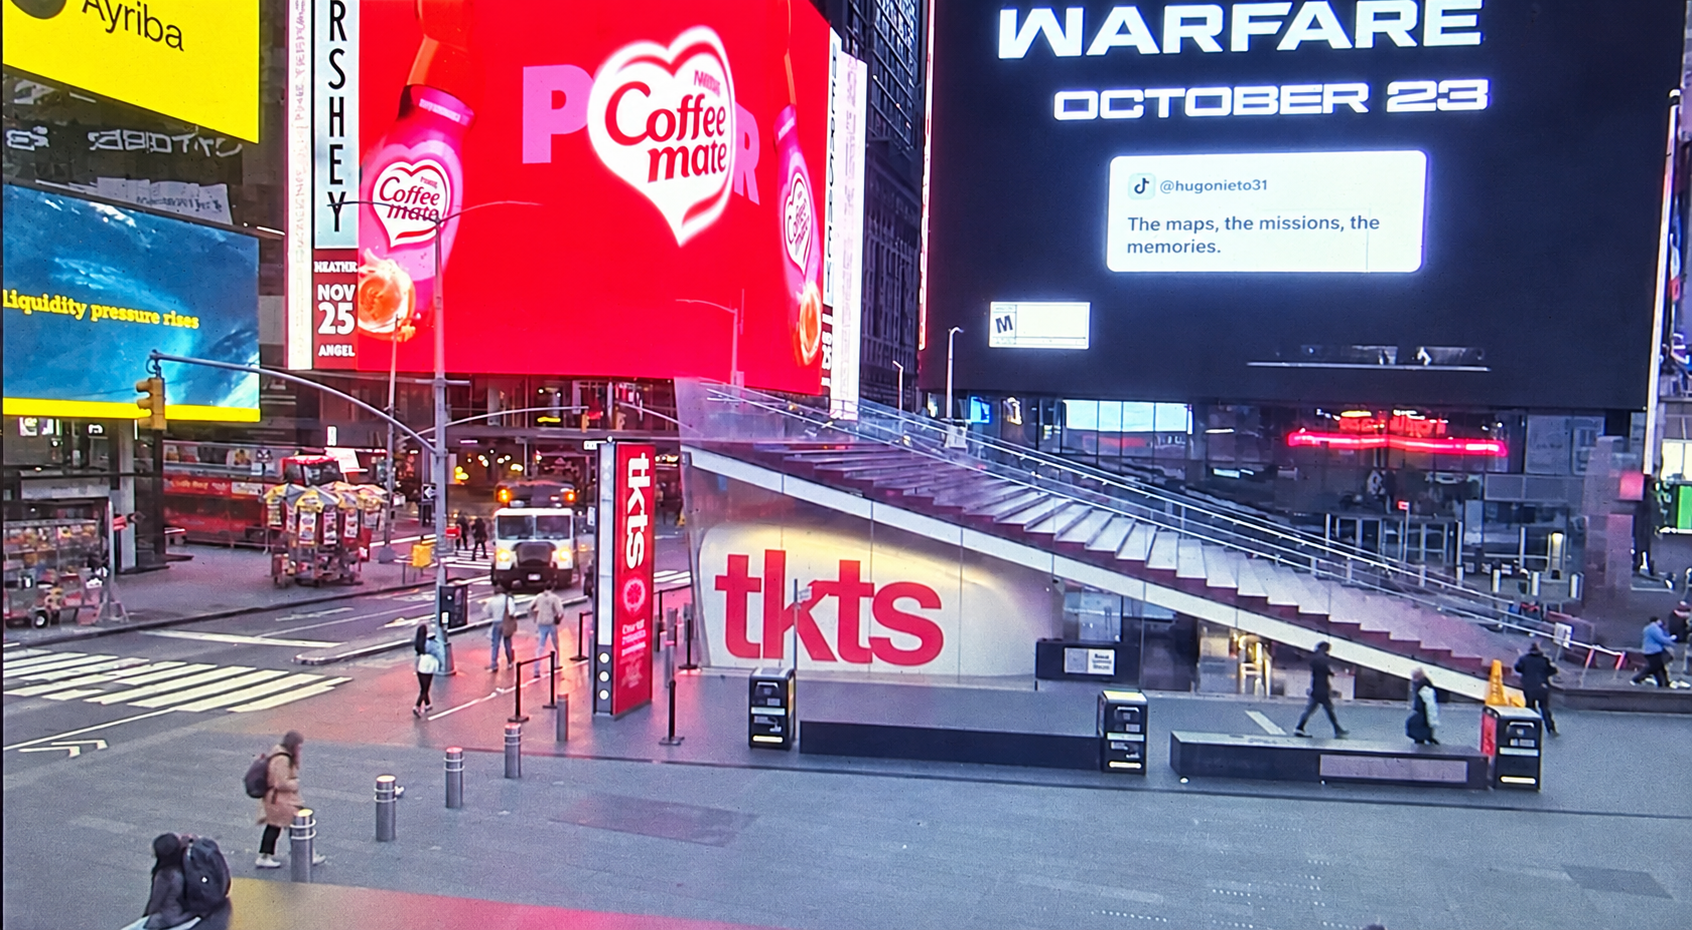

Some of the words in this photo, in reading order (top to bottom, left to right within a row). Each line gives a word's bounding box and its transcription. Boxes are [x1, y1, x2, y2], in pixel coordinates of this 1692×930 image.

[998, 0, 1483, 59] WARFARE
[604, 80, 727, 147] Coffee
[1053, 83, 1370, 121] OCTOBER
[1386, 78, 1490, 113] 23
[647, 139, 728, 183] mate
[379, 176, 440, 206] Coffee
[1159, 179, 1268, 195] @hugonieto31
[387, 204, 440, 222] mate
[1127, 216, 1161, 231] The
[1166, 217, 1220, 233] maps,
[1225, 215, 1254, 230] the
[1259, 215, 1345, 232] missions,
[1350, 214, 1380, 230] the
[1127, 238, 1222, 254] memories.
[317, 284, 356, 301] NOV
[3, 289, 87, 320] Liquidity
[90, 303, 160, 325] pressure
[162, 310, 199, 329] rises
[317, 301, 356, 335] 25
[995, 314, 1013, 334] M
[318, 344, 356, 357] ANGEL
[626, 452, 651, 569] tkts
[715, 549, 944, 667] tkts
